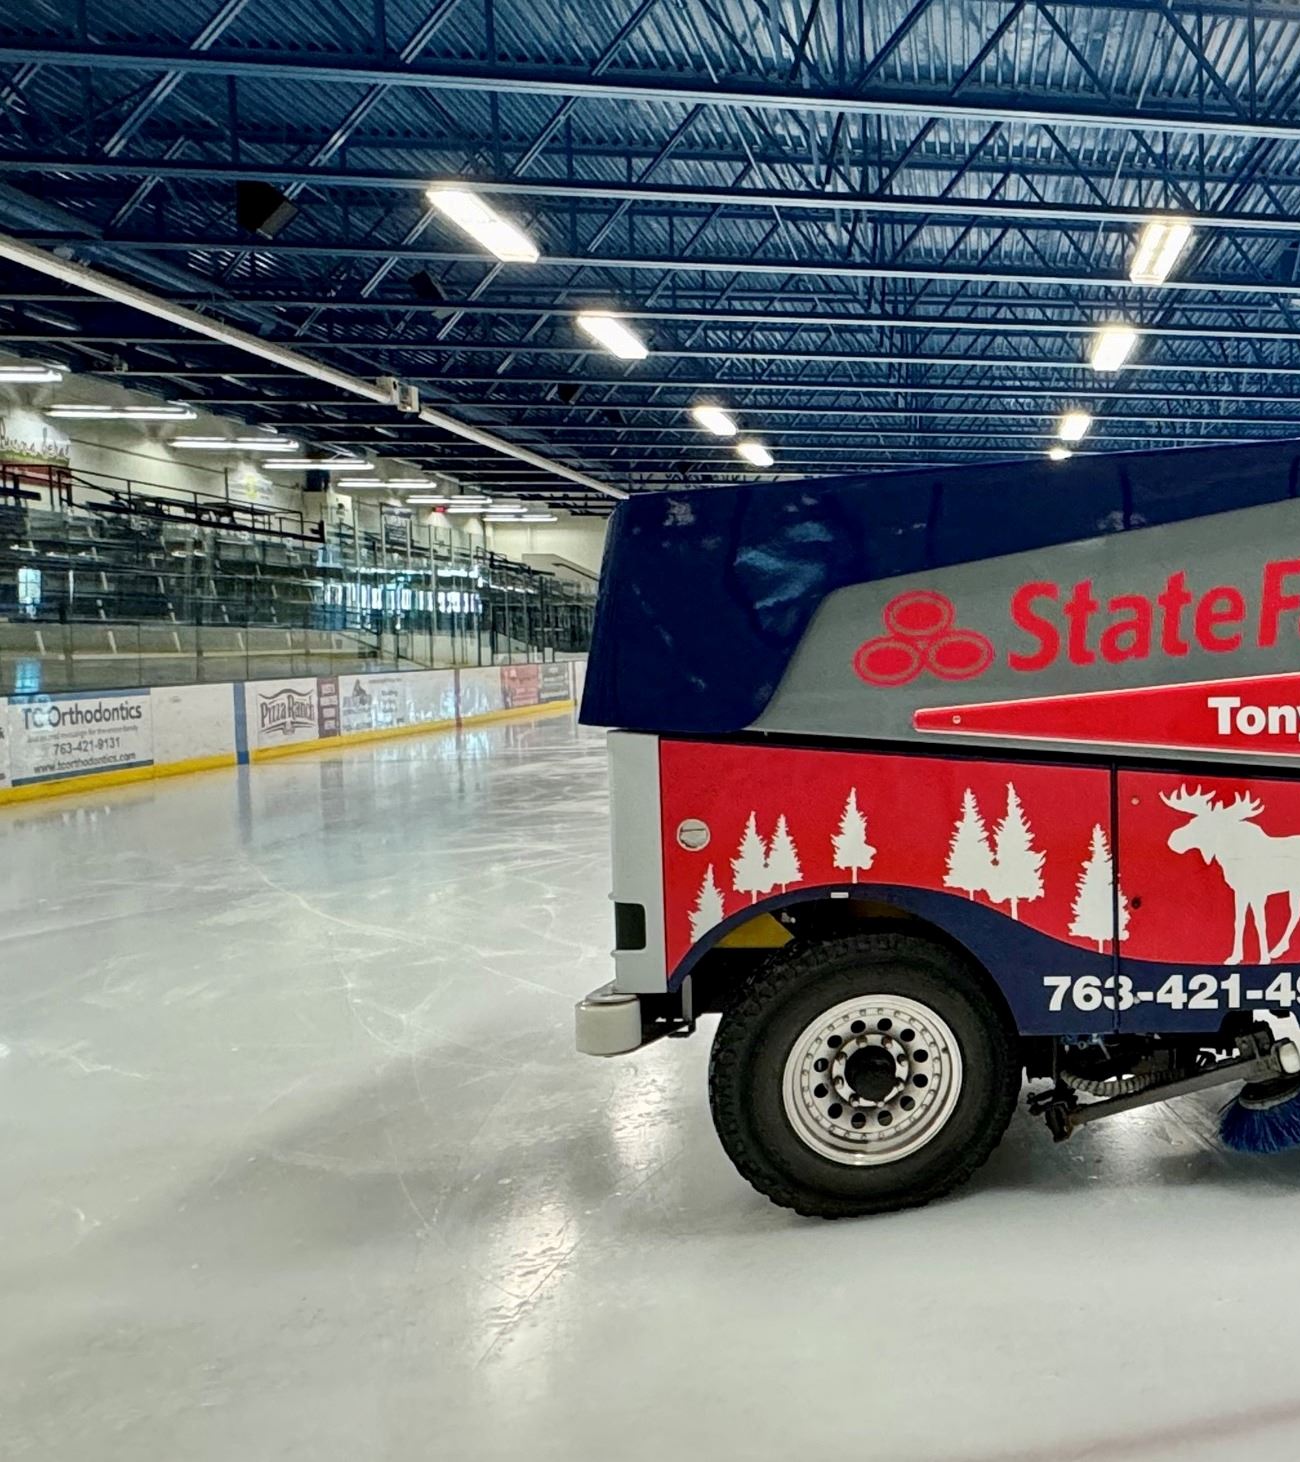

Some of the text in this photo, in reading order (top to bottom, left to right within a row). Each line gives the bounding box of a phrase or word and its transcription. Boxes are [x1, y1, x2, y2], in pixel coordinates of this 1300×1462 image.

[1007, 569, 1247, 673] State
[260, 694, 314, 728] Pizza Ranch
